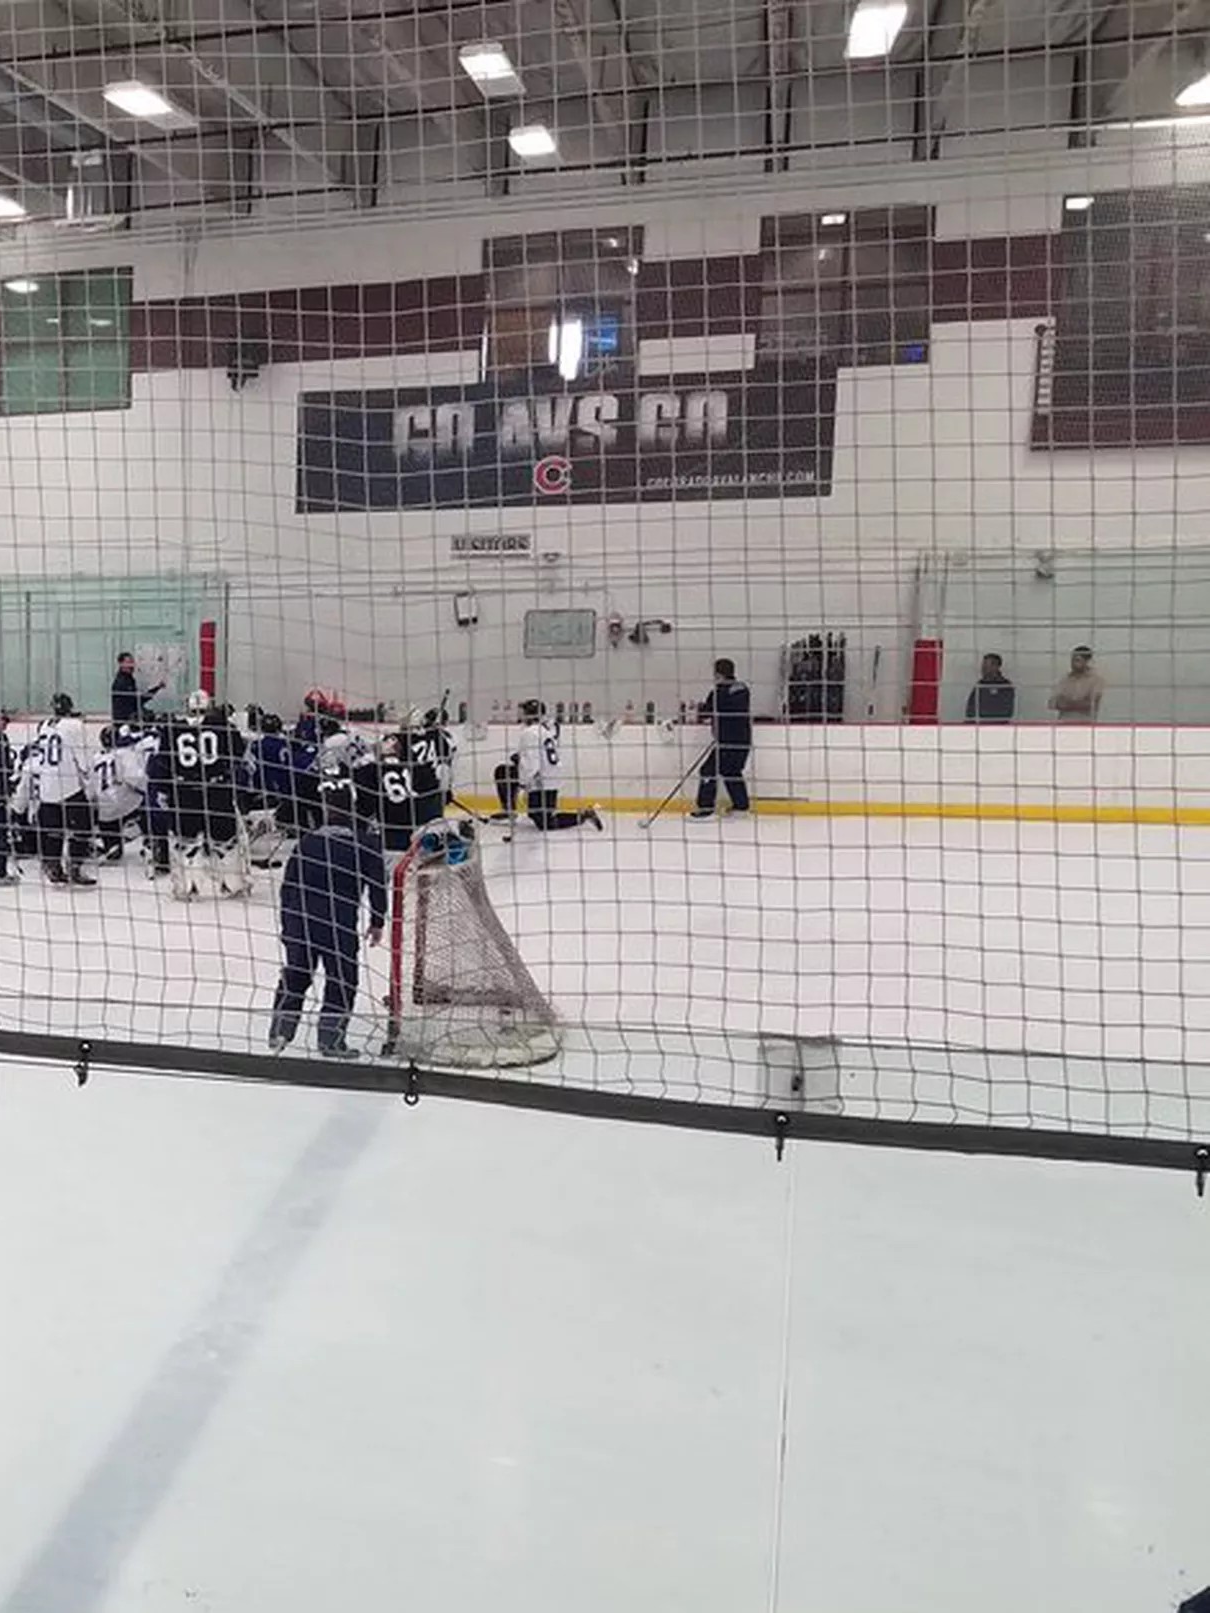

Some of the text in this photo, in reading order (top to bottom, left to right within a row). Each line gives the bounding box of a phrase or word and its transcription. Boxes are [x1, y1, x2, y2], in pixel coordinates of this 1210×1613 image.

[392, 390, 729, 455] GO AVS GO
[176, 730, 218, 768] 60
